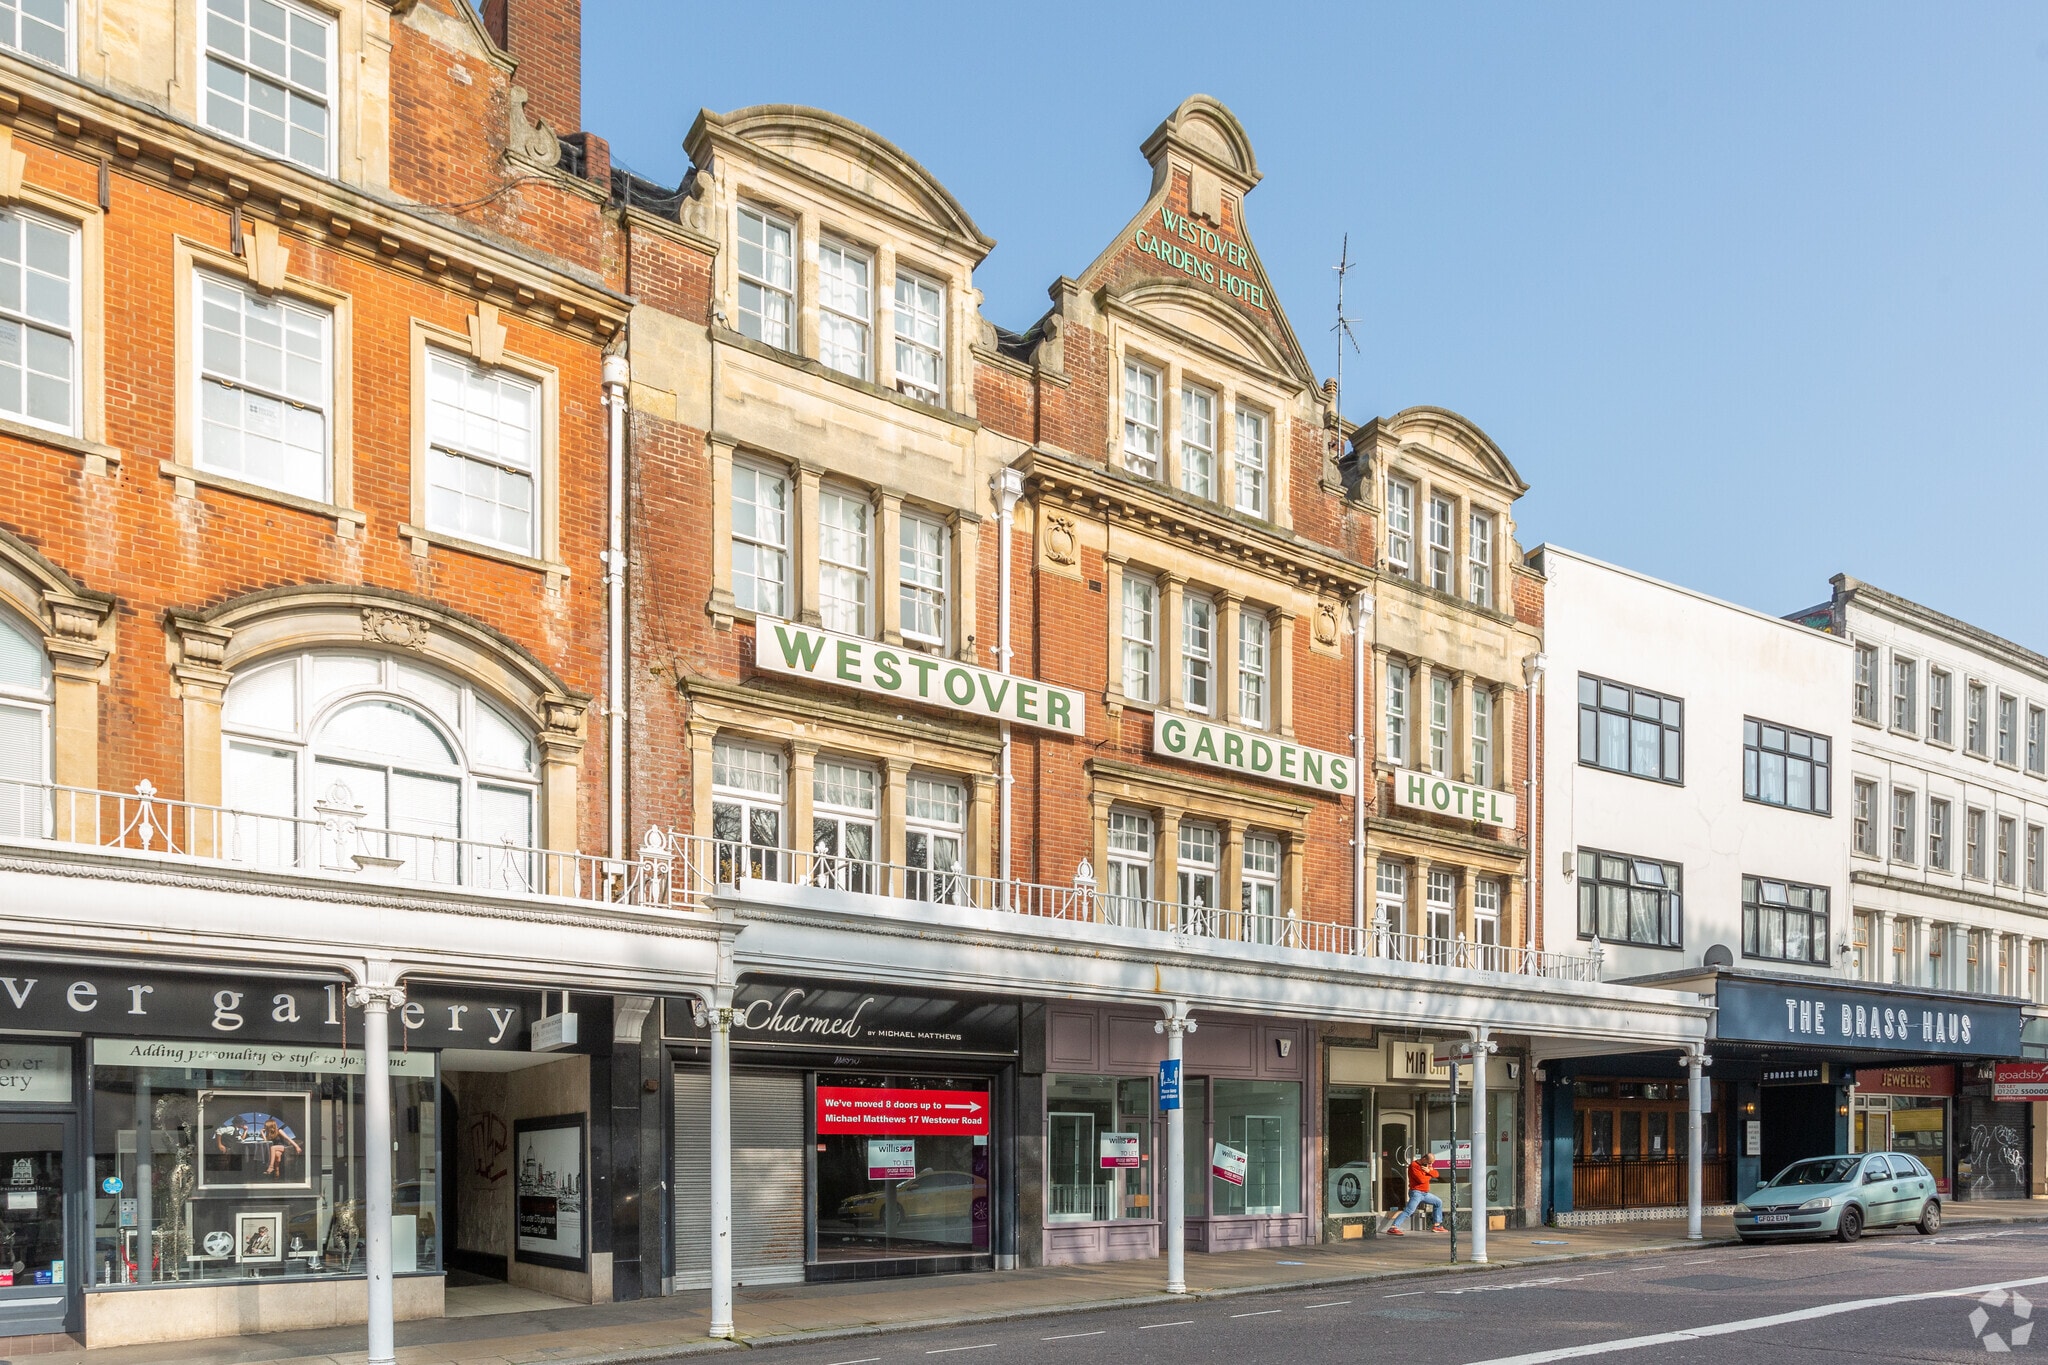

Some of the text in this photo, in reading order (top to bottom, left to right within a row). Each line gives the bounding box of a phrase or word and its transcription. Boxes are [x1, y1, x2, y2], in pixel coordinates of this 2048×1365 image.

[1160, 206, 1248, 270] WESTOVER
[1135, 229, 1268, 311] GARDENS HOTEL
[774, 626, 1073, 729] WESTOVER
[1161, 717, 1349, 791] GARDENS
[1408, 773, 1505, 825] HOTEL
[211, 984, 515, 1044] galery
[743, 988, 875, 1038] Charmed
[1786, 999, 1972, 1045] THE BRASS HAUS
[878, 1030, 915, 1039] MICHAEL
[918, 1032, 962, 1041] MATTHEWS
[129, 1043, 184, 1063] Adding
[271, 1051, 286, 1062] &
[324, 1054, 336, 1064] to
[1406, 1051, 1426, 1075] MIA
[1769, 1071, 1795, 1080] BRASS
[1798, 1069, 1818, 1078] HAUS
[1882, 1073, 1931, 1089] JEWELLERS
[1998, 1070, 2045, 1082] goadsby
[854, 1100, 883, 1109] moved
[885, 1100, 891, 1109] 8
[893, 1101, 918, 1109] doors
[920, 1102, 931, 1111] up
[933, 1102, 942, 1110] to
[825, 1114, 983, 1125] Michael Matthews 17 Westover Road
[878, 1143, 900, 1153] willis
